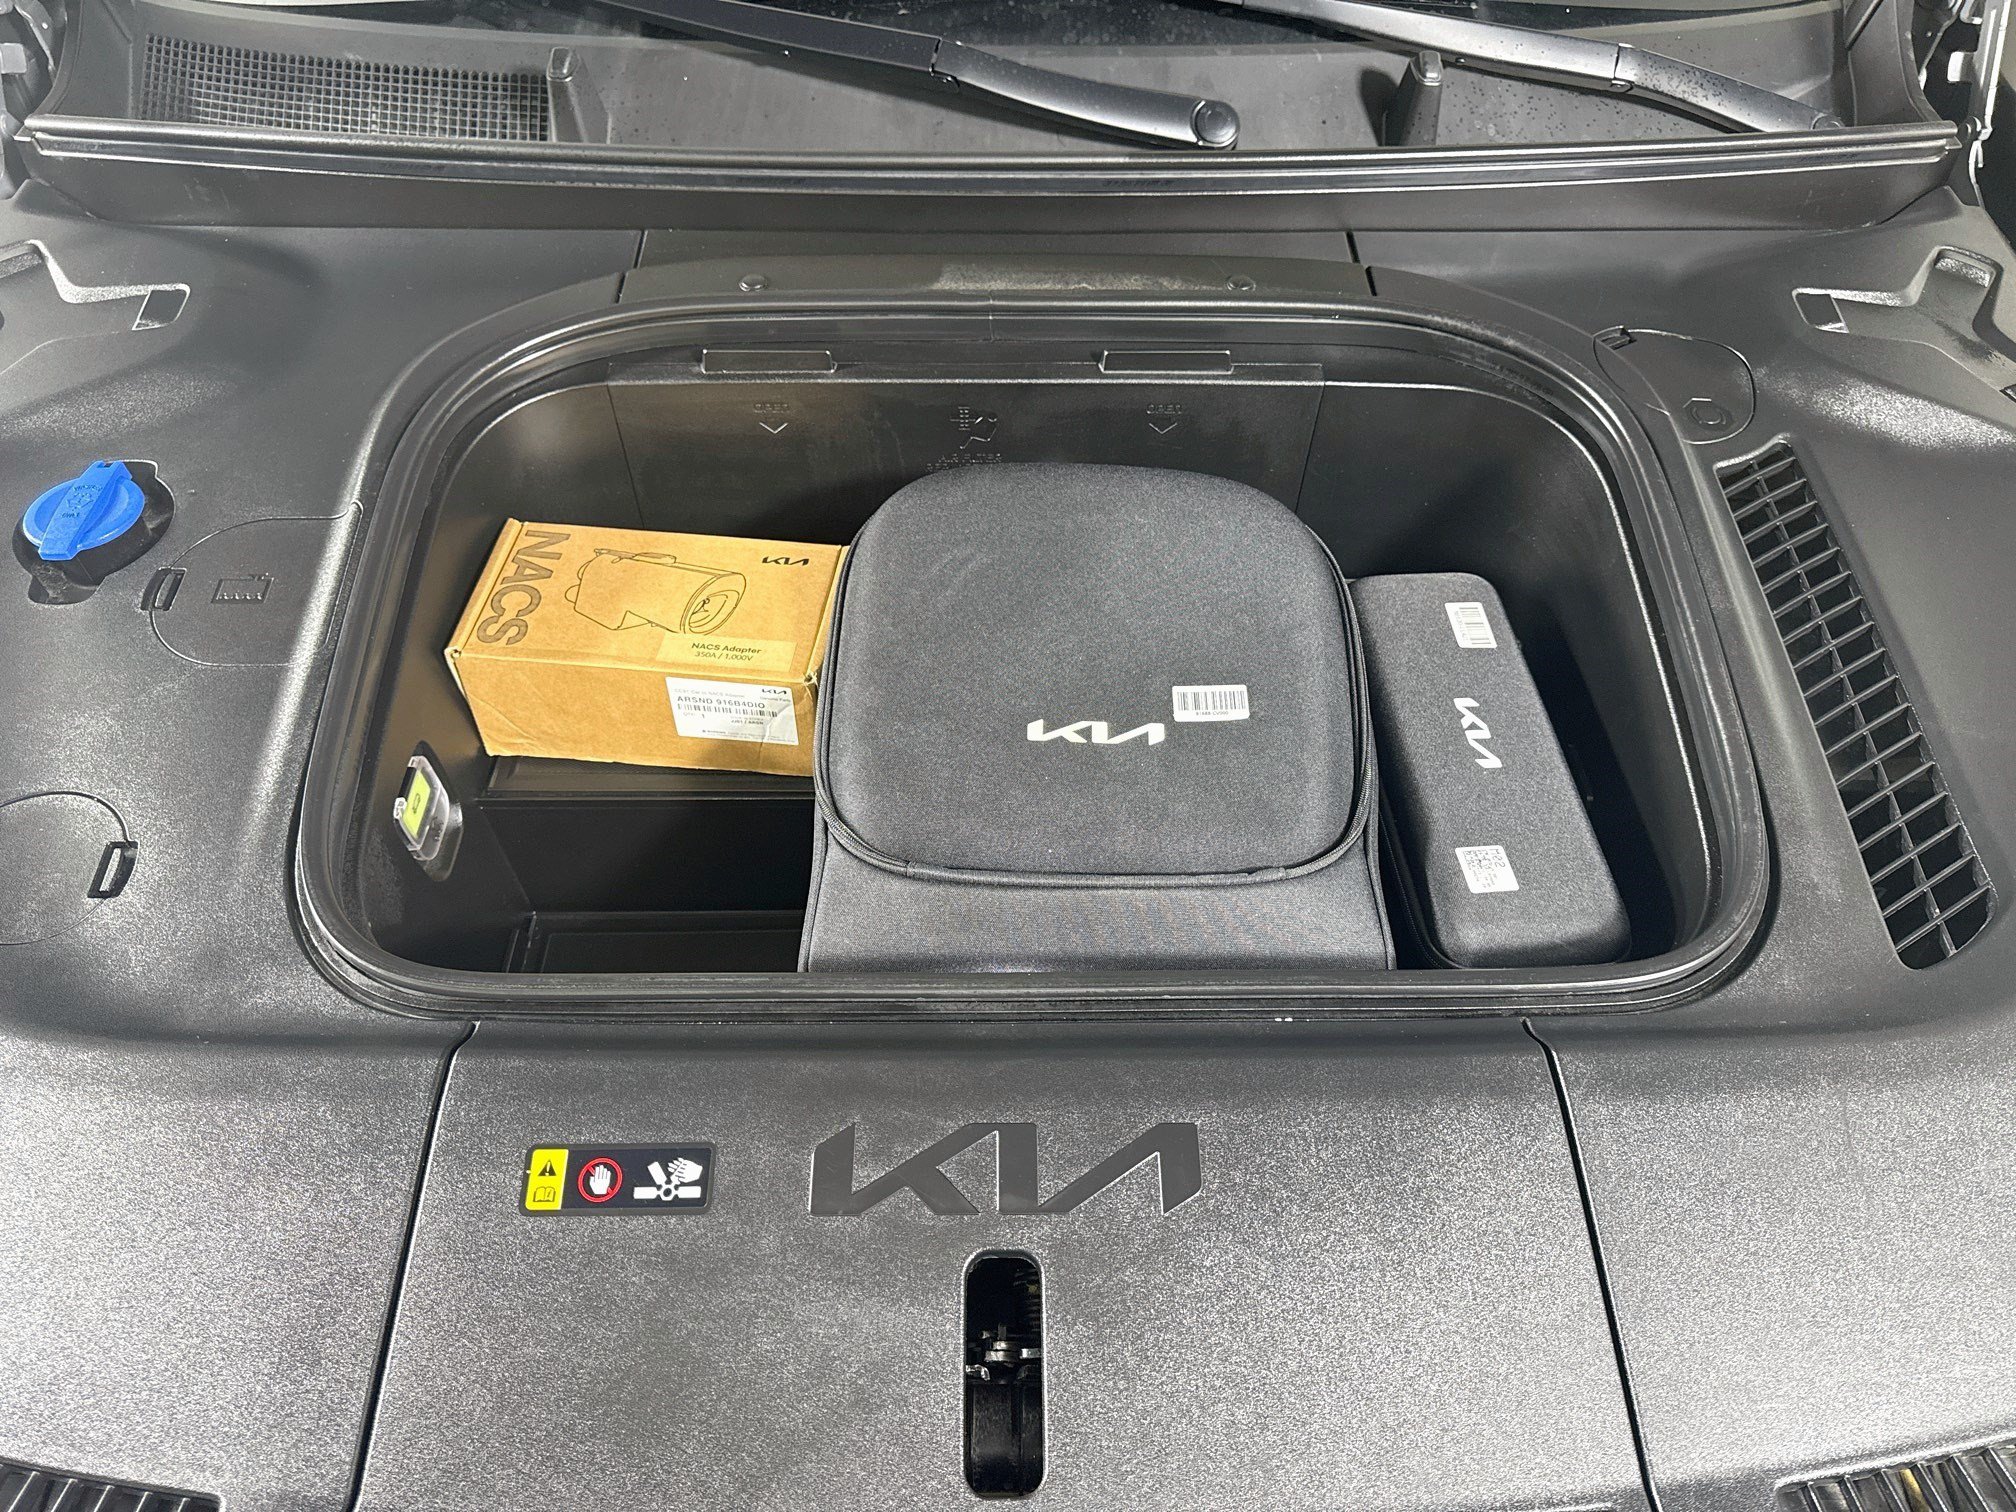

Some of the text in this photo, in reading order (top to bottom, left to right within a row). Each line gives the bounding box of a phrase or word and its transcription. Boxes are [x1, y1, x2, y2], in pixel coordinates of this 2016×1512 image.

[762, 556, 809, 567] KIA
[476, 530, 571, 646] NACS
[691, 642, 762, 654] NACS Adapter
[677, 696, 713, 705] ARSND
[1027, 719, 1165, 745] KIA
[1453, 697, 1502, 768] KIA
[810, 1122, 1201, 1216] KIA
